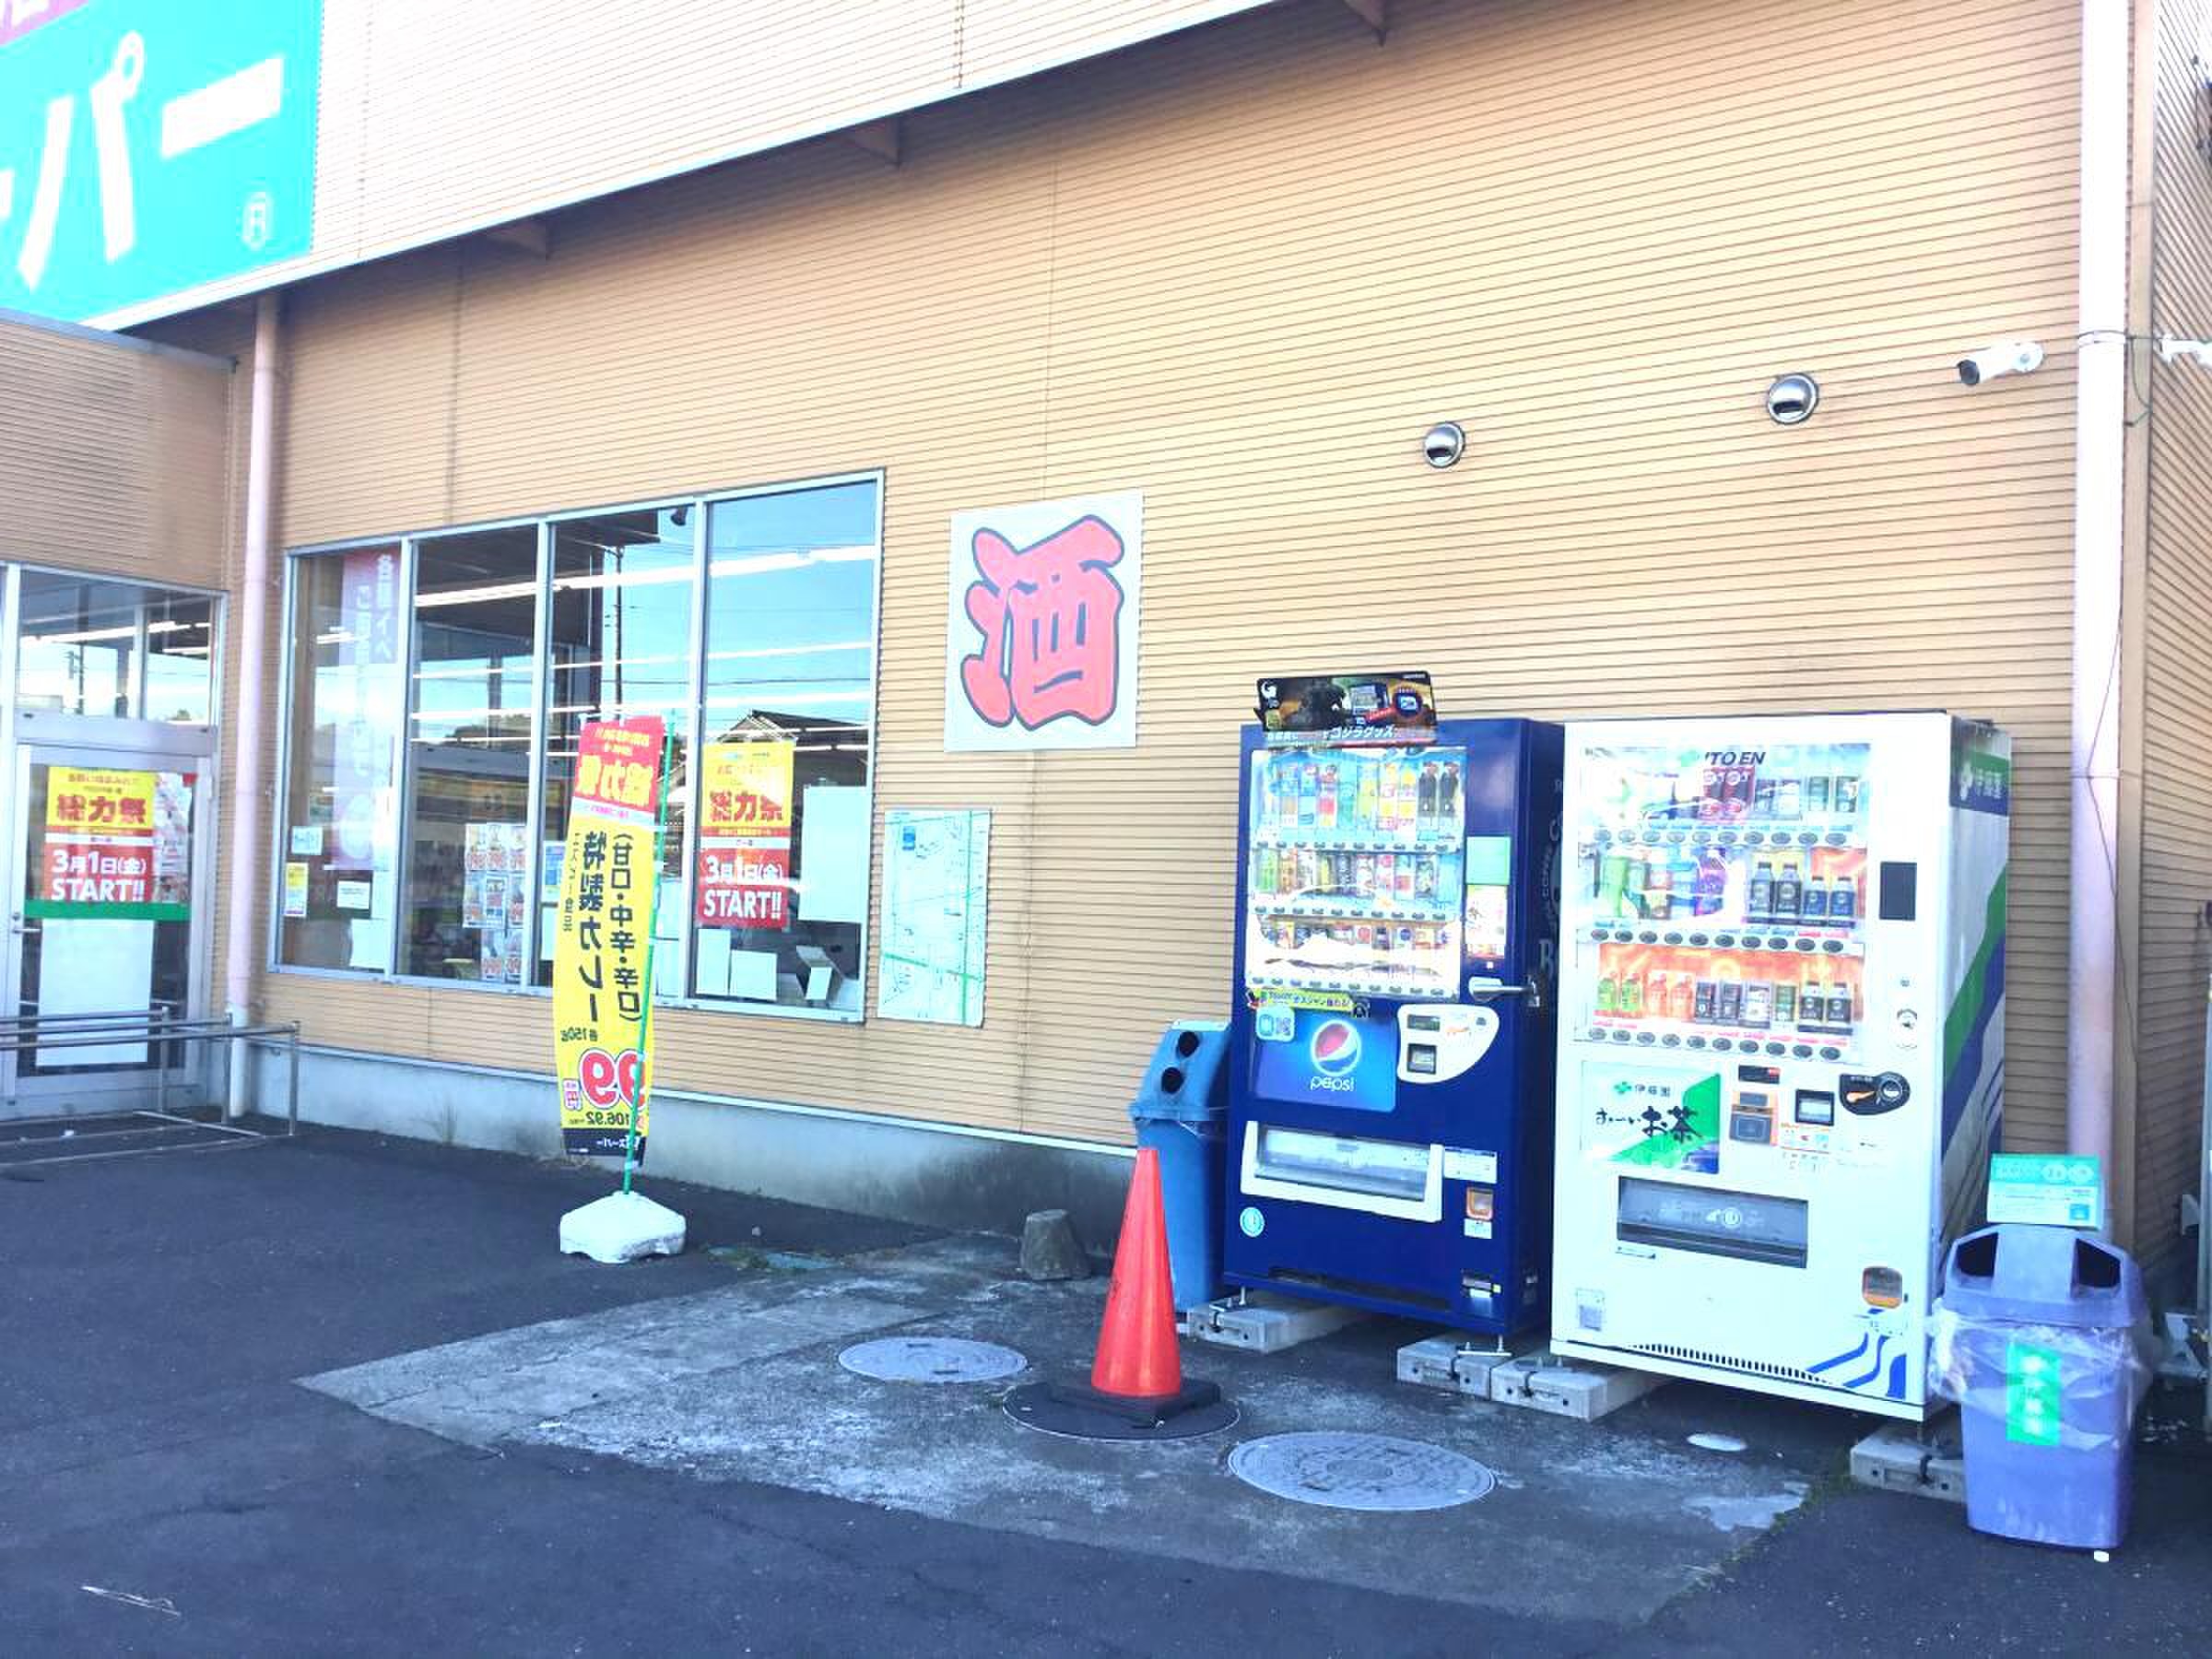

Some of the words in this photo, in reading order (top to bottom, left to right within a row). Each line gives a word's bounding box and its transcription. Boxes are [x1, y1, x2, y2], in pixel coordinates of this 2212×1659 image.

[0, 30, 284, 292] パー
[960, 514, 1124, 731] 酒
[1739, 751, 1766, 766] EN
[57, 794, 147, 824] 総力祭
[51, 877, 146, 902] START!!
[703, 888, 782, 920] START!!
[1310, 1076, 1355, 1092] pepsi
